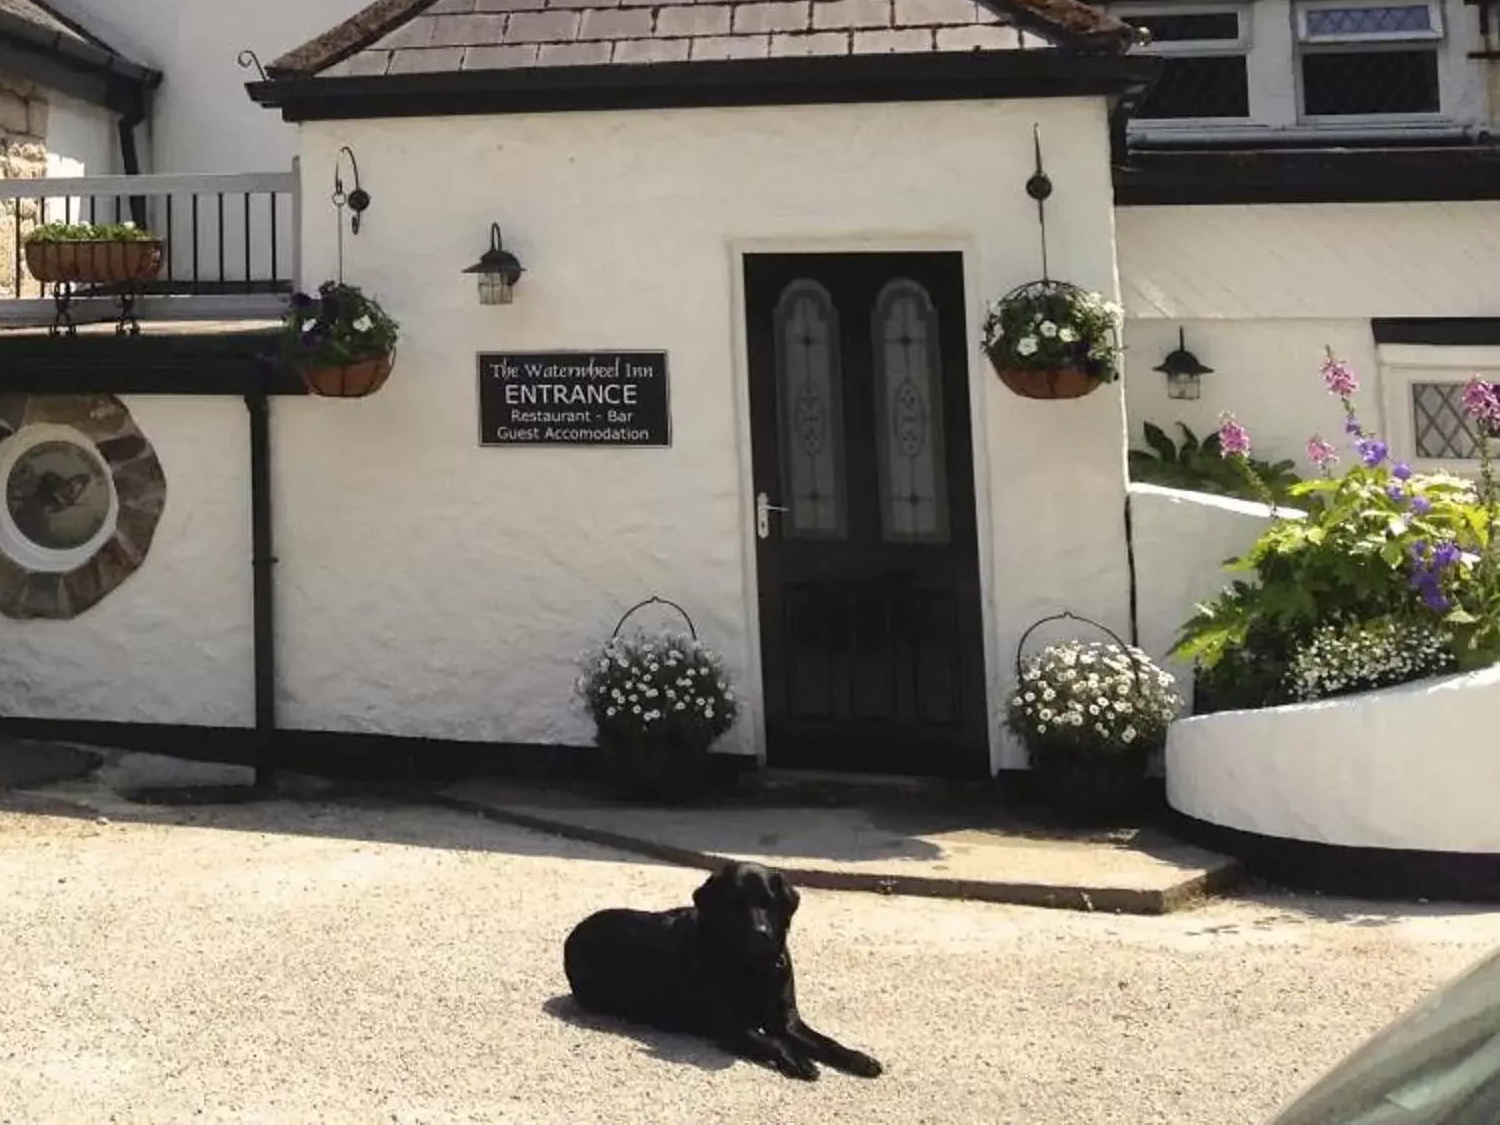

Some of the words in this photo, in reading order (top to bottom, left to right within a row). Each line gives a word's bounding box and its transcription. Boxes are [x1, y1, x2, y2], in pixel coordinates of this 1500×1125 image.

[491, 358, 519, 381] The
[626, 363, 653, 378] Inn
[505, 384, 638, 404] ENTRANCE
[511, 409, 590, 422] Restaurant
[607, 409, 634, 422] Bar
[497, 426, 539, 440] Guest
[545, 426, 649, 440] Accomodation
